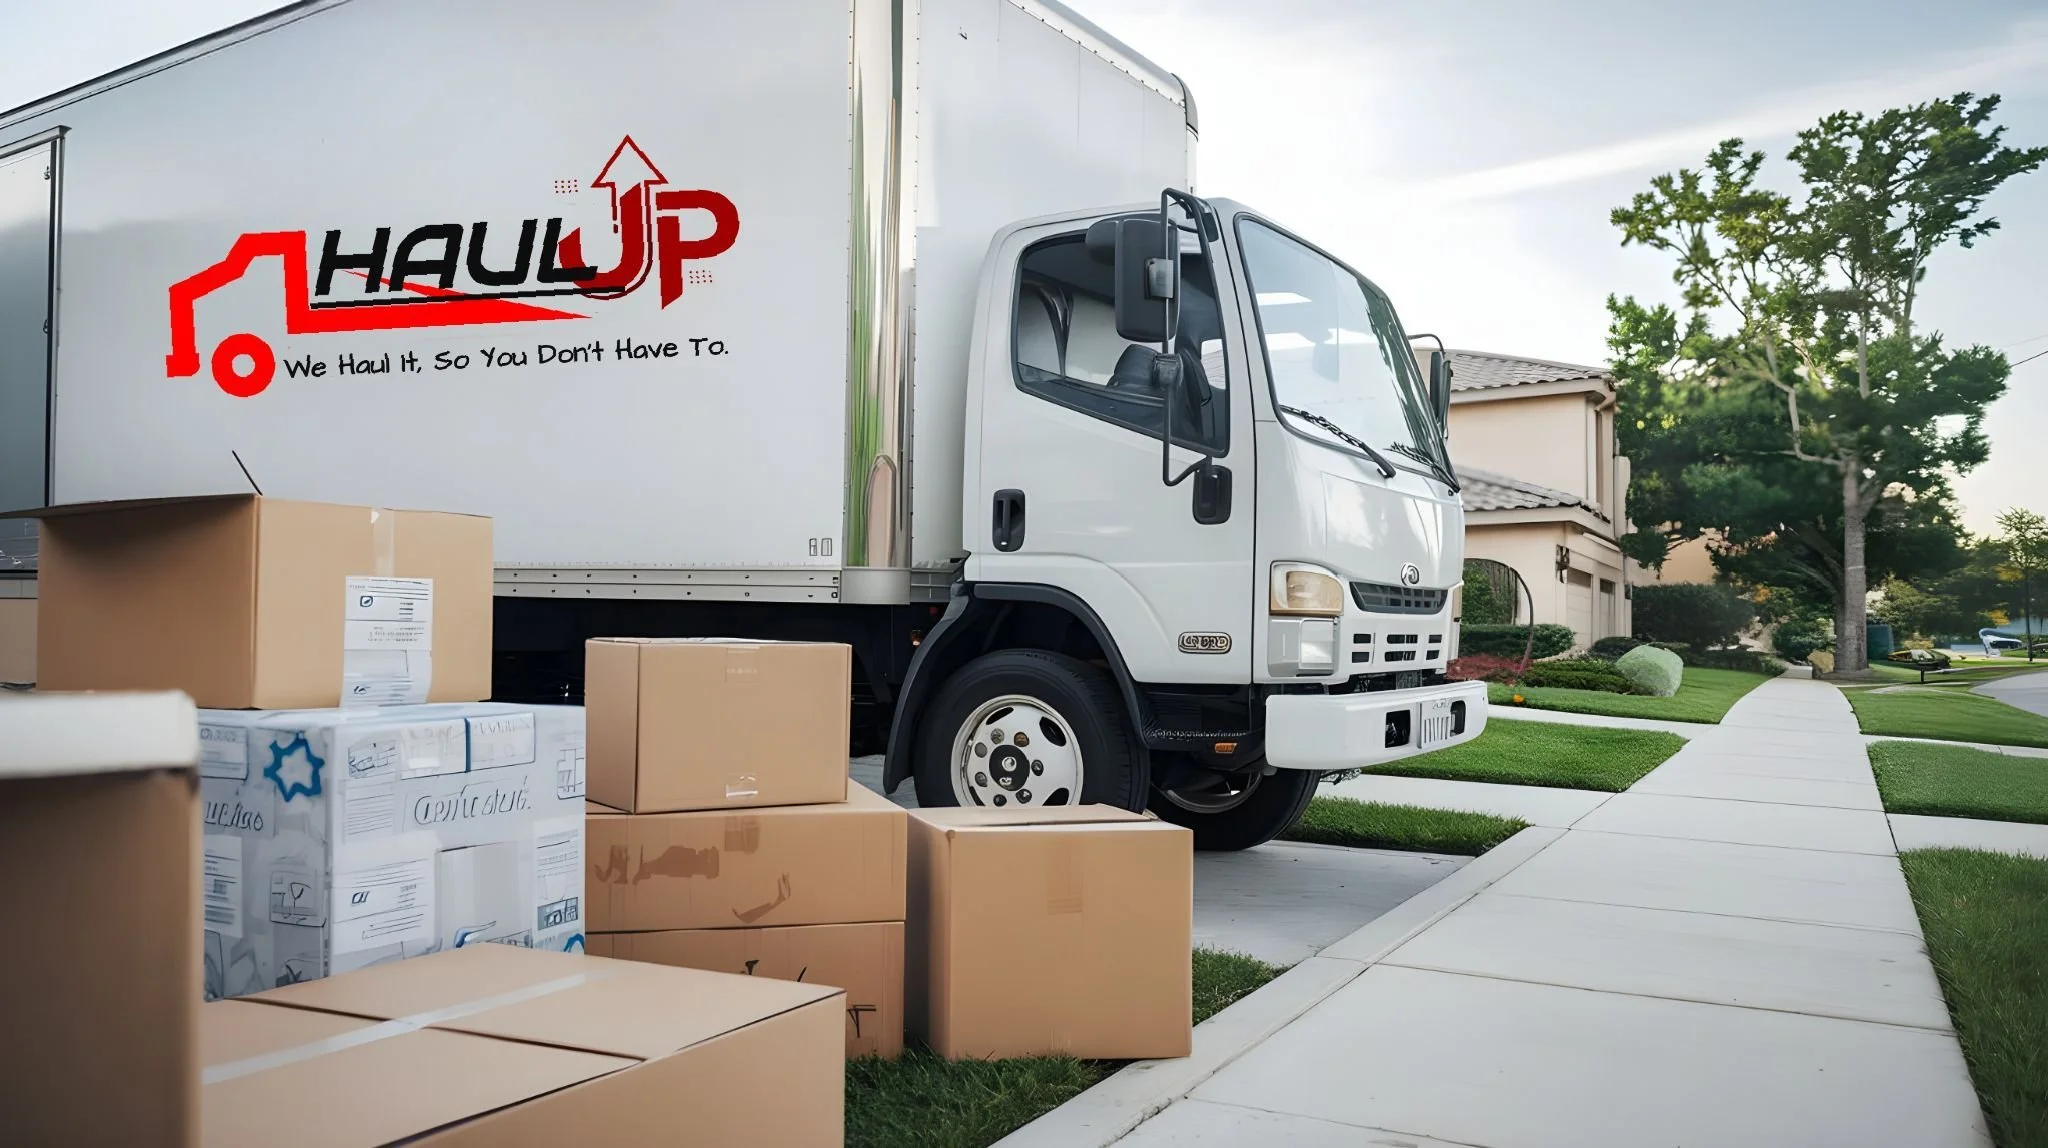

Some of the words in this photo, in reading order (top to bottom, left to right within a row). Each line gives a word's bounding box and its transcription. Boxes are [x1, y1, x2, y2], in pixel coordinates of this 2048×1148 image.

[282, 354, 327, 379] We
[338, 352, 390, 376] Haul
[400, 350, 422, 374] It,
[434, 350, 470, 371] So
[479, 346, 528, 368] You
[537, 340, 604, 364] Don't
[614, 337, 679, 361] Have
[688, 337, 729, 357] To.
